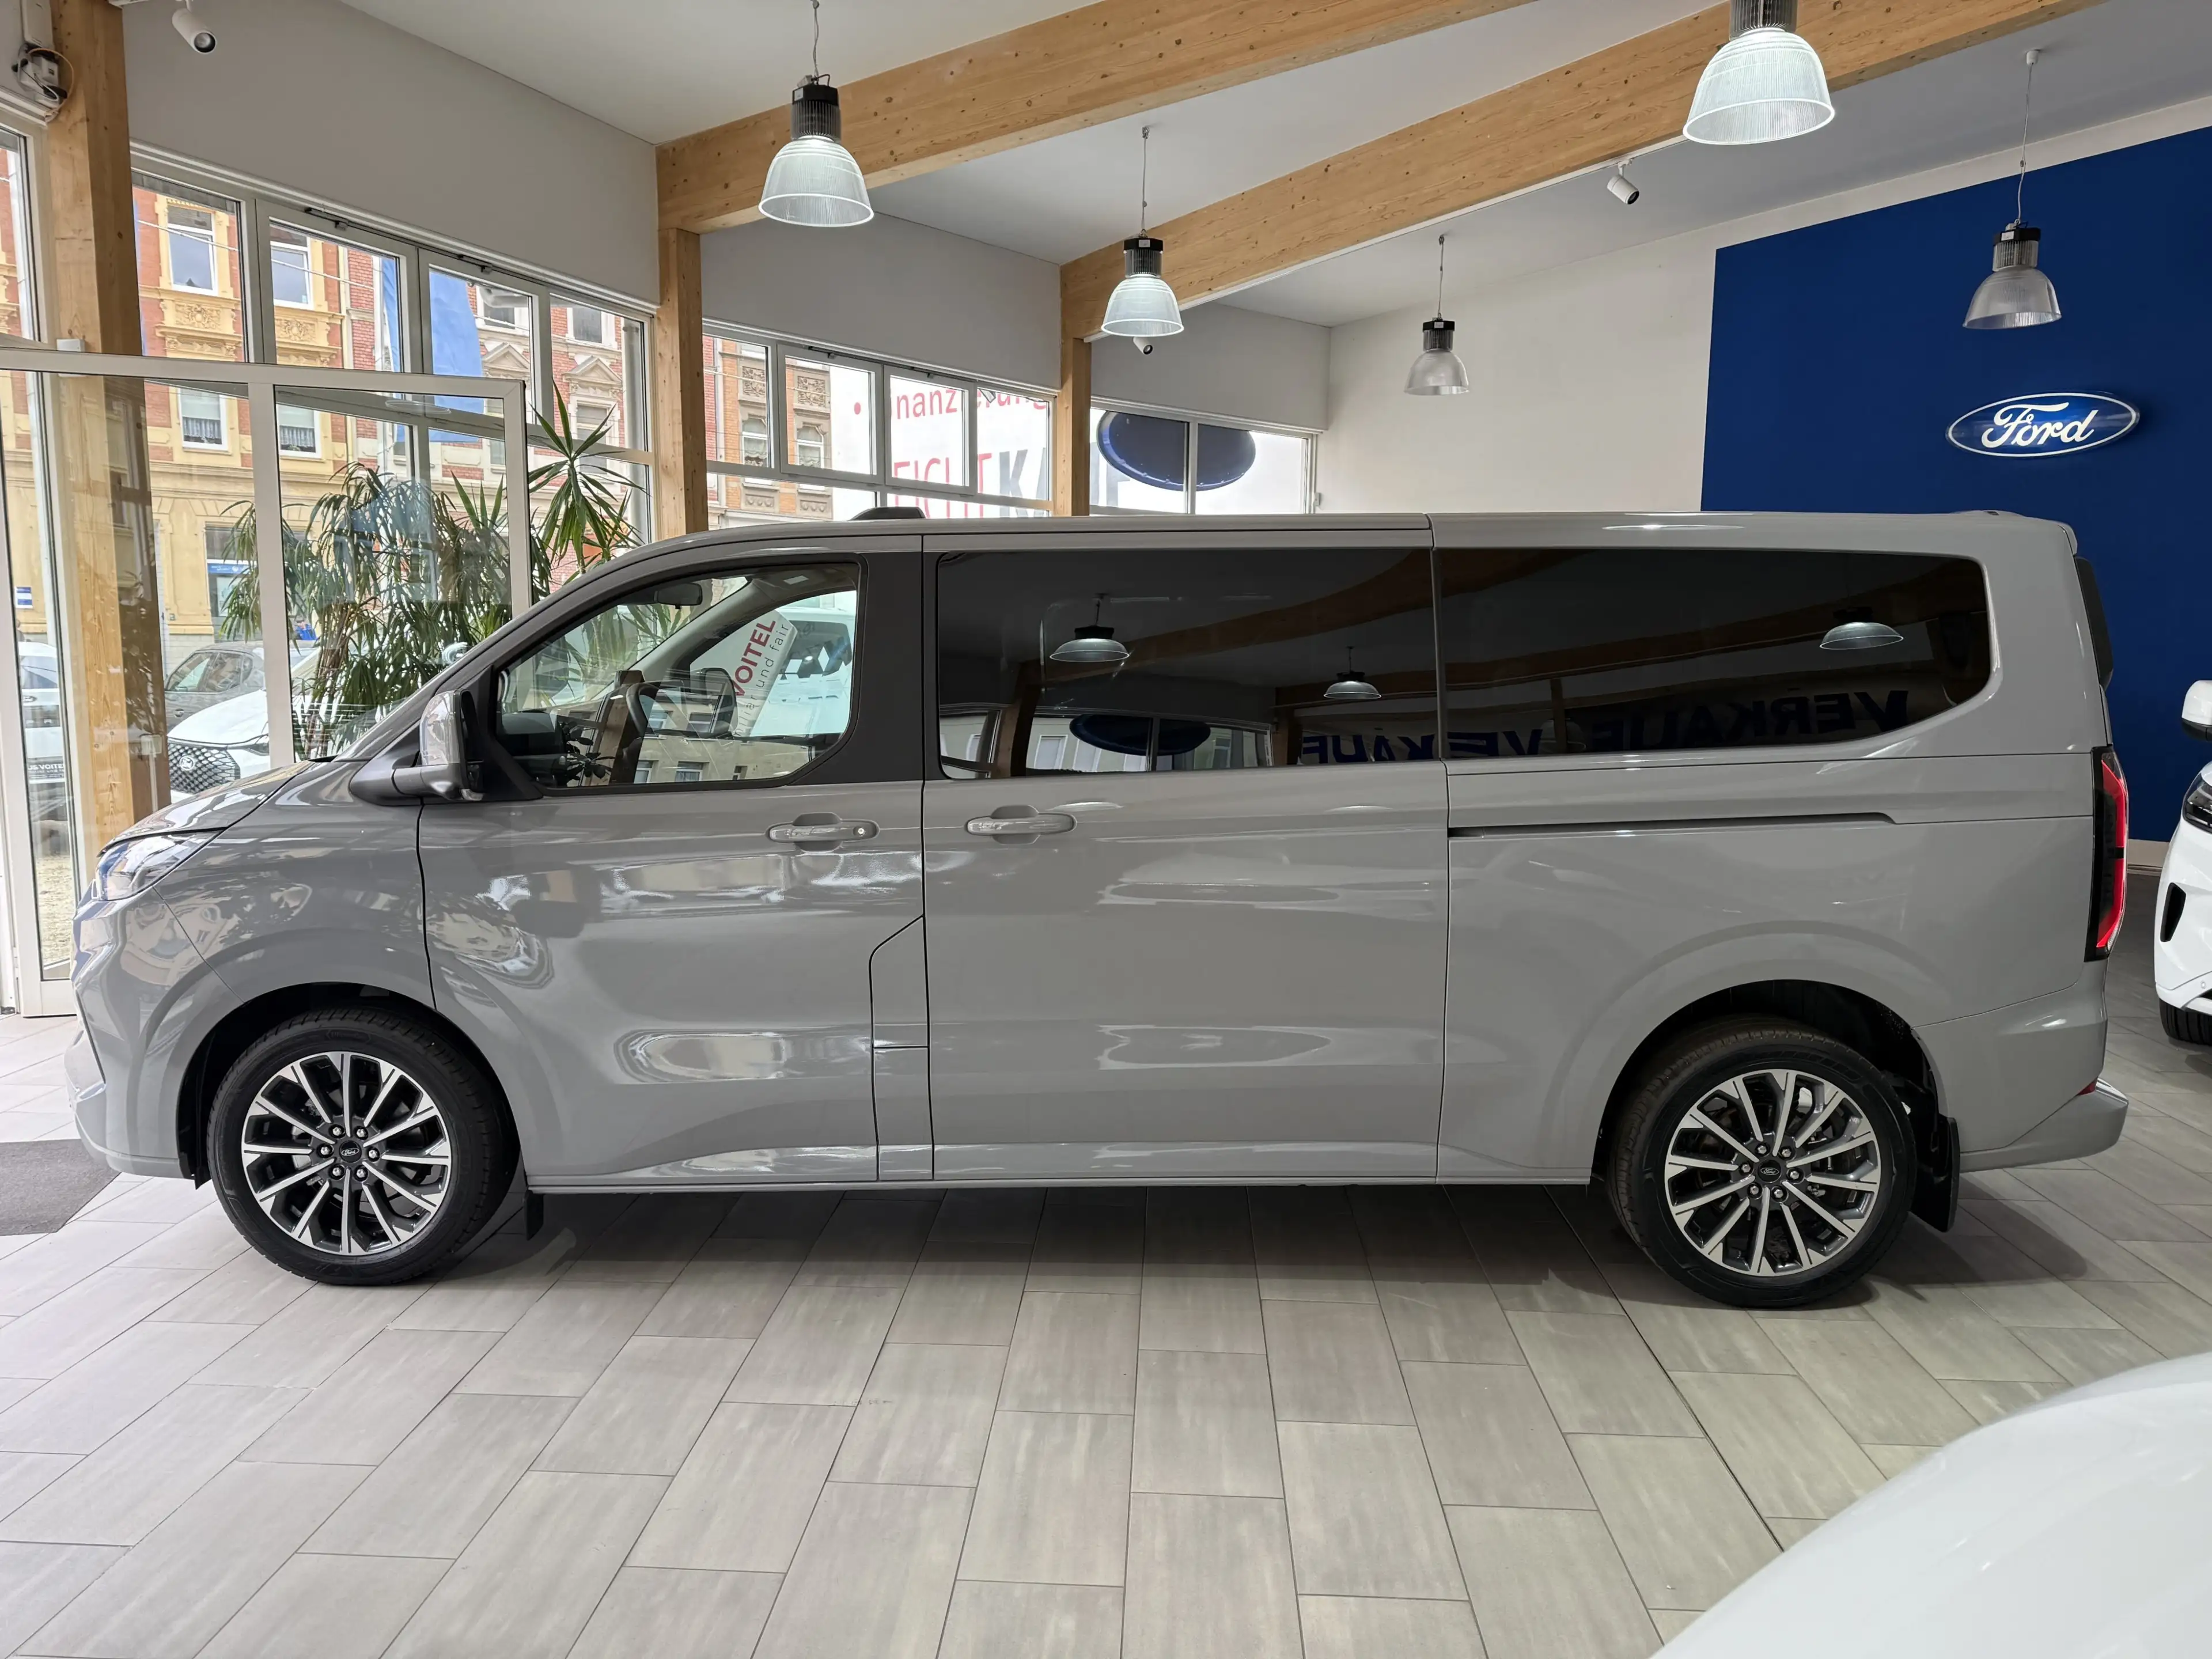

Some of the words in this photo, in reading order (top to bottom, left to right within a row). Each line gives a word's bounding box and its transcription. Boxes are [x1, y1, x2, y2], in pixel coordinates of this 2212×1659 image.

[1982, 402, 2099, 448] Ford
[733, 620, 776, 696] VOITEL
[756, 657, 774, 688] und
[770, 624, 789, 652] fair
